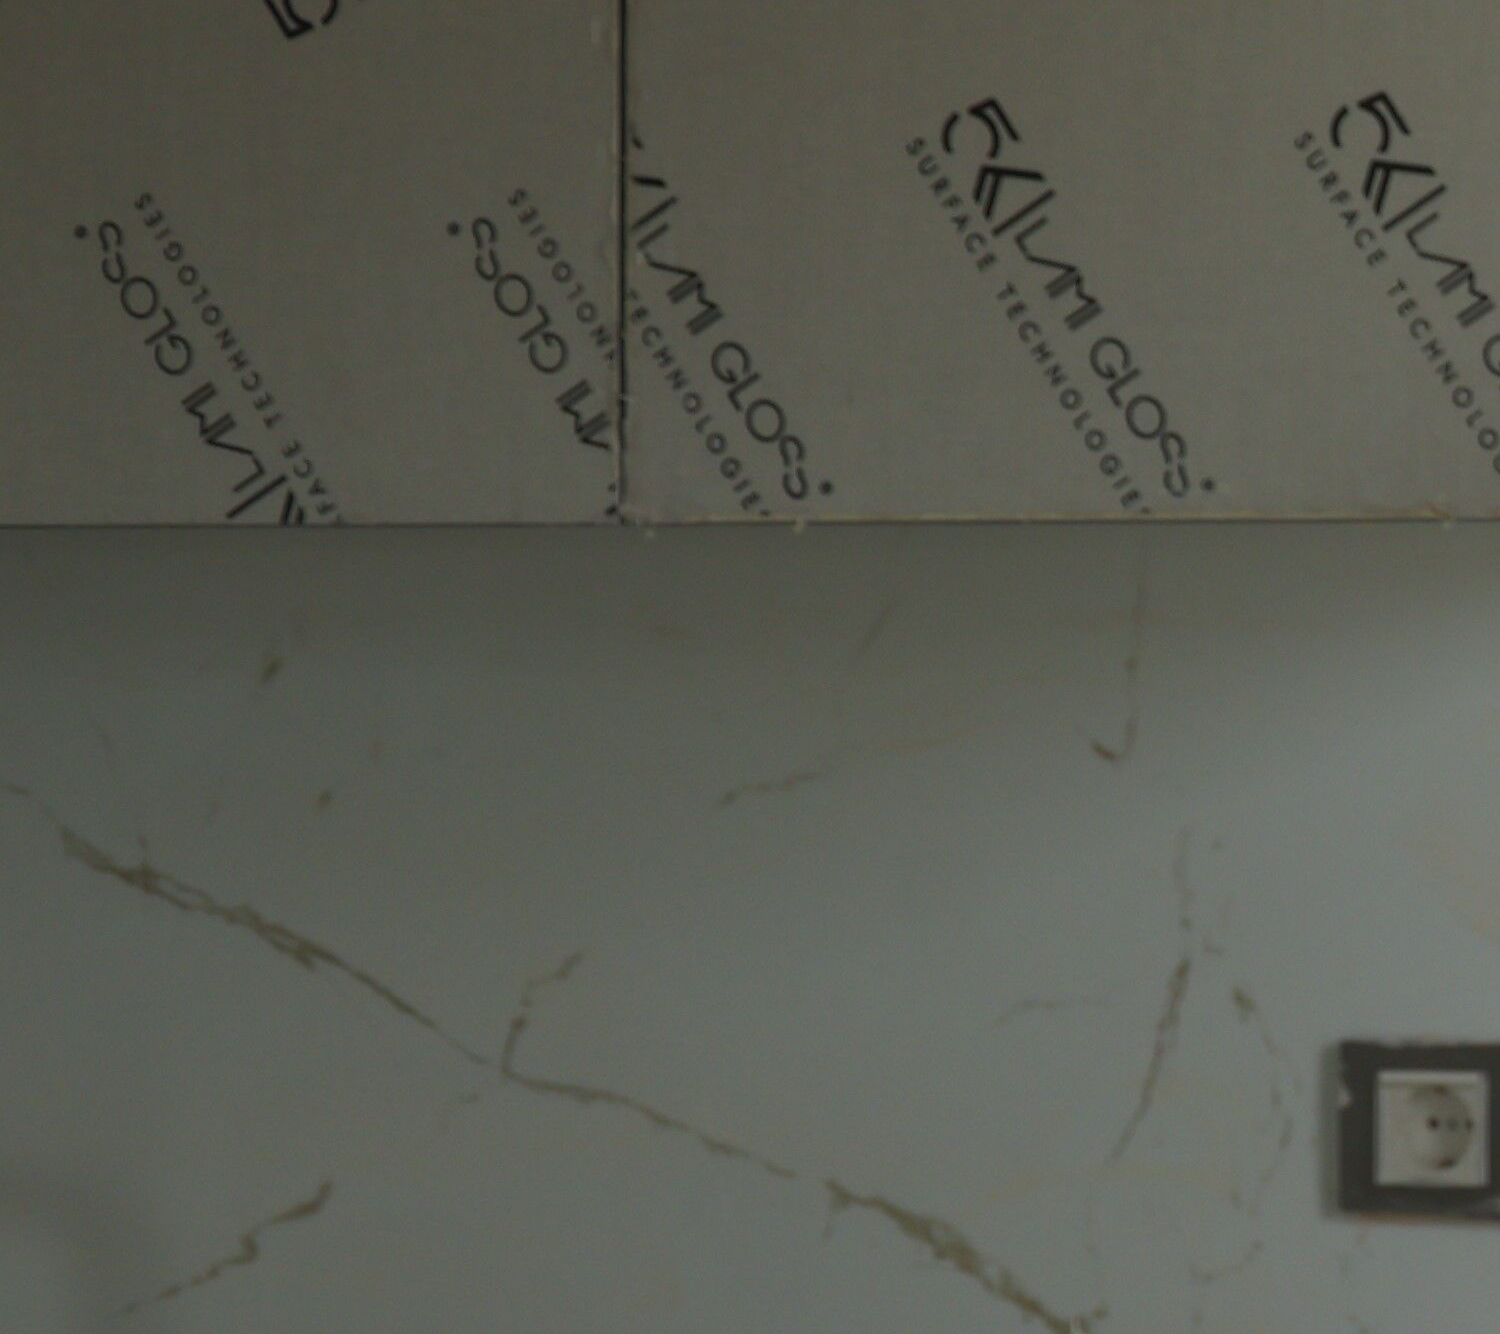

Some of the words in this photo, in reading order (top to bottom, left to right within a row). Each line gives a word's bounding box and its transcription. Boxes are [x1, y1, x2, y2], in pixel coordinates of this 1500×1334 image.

[134, 193, 282, 429] TECHNOLOGIES
[1294, 131, 1387, 267] SURFACE
[906, 137, 997, 272] SURFACE
[997, 281, 1157, 519] TECHNOLOGIE
